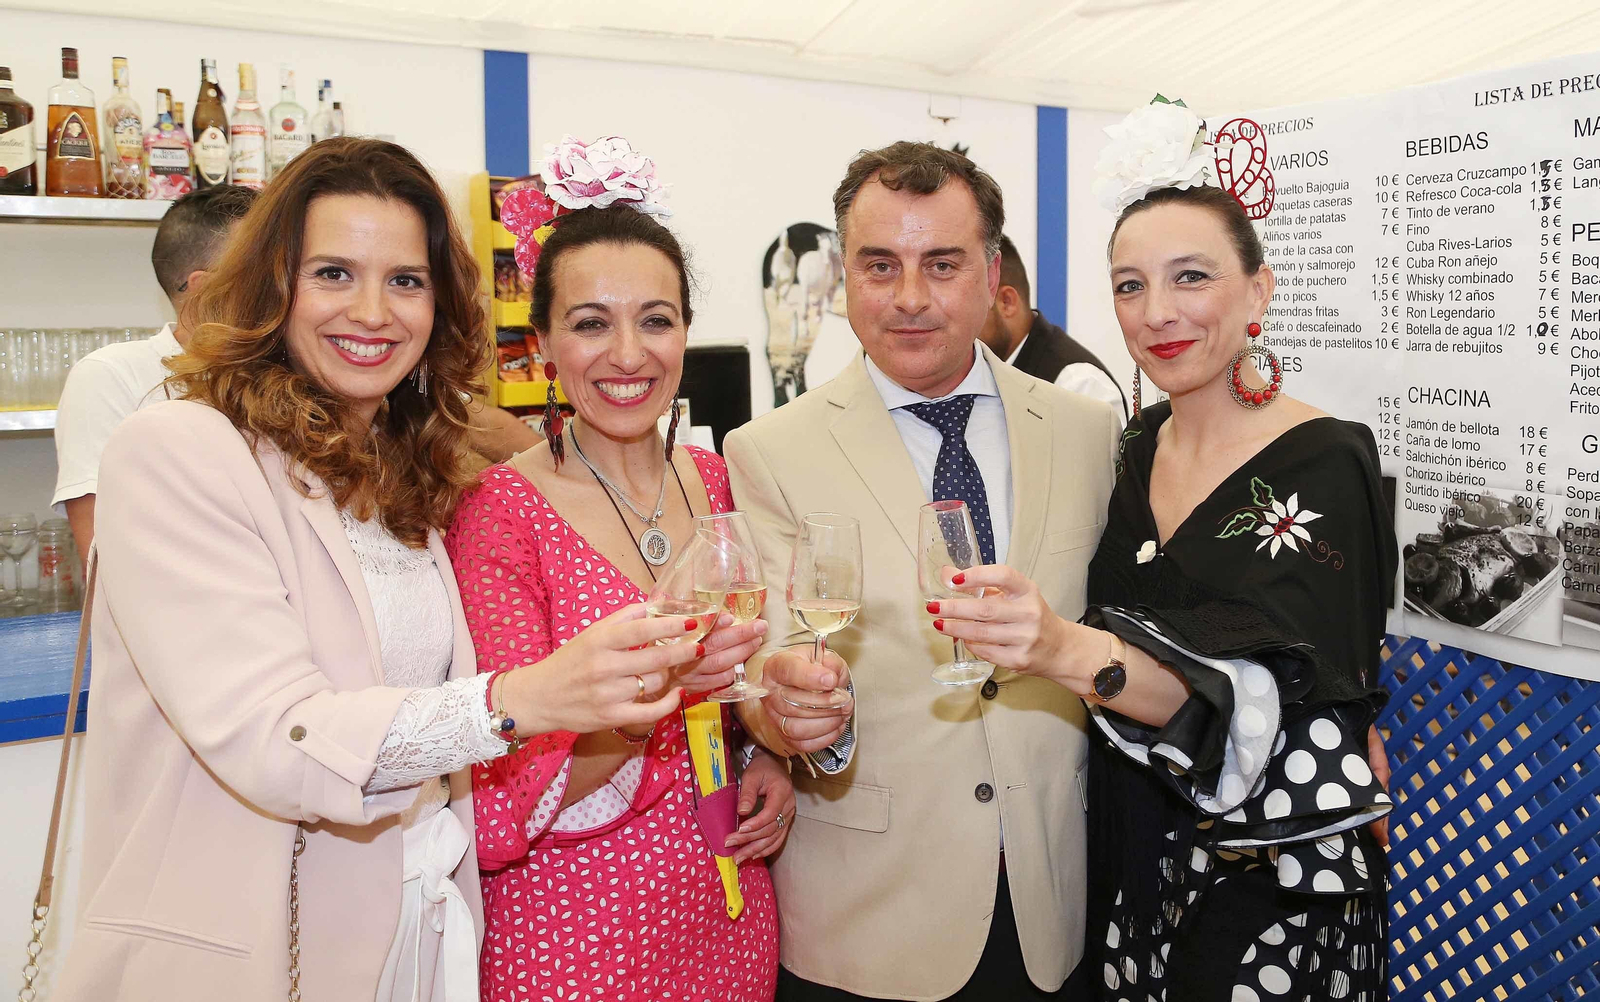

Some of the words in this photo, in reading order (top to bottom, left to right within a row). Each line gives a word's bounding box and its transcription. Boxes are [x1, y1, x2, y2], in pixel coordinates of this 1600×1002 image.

[1474, 86, 1525, 107] LISTA
[1530, 80, 1553, 99] DE
[1261, 117, 1314, 135] PRECIOS
[1406, 132, 1489, 158] BEBIDAS
[1270, 149, 1329, 171] VARIOS
[1406, 172, 1453, 186] Cerveza
[1456, 164, 1527, 182] Cruzcampo
[1306, 180, 1349, 196] Bajoguia
[1375, 175, 1388, 187] 10
[1392, 174, 1400, 186] €
[1406, 188, 1456, 202] Refresco
[1460, 182, 1522, 198] Coca-cola
[1554, 178, 1563, 191] €
[1314, 196, 1352, 209] caseras
[1375, 192, 1388, 204] 10
[1392, 191, 1400, 202] €
[1406, 206, 1432, 219] Tinto
[1436, 205, 1450, 217] de
[1454, 202, 1495, 216] verano
[1553, 196, 1562, 210] €
[1264, 214, 1292, 227] Tortilla
[1295, 213, 1307, 225] de
[1310, 213, 1346, 226] patatas
[1382, 208, 1388, 220] 7
[1392, 207, 1400, 219] €
[1406, 224, 1430, 236] Fino
[1540, 215, 1548, 228] 8
[1552, 214, 1562, 228] €
[1263, 230, 1290, 242] Aliños
[1293, 228, 1322, 241] varios
[1382, 224, 1388, 236] 7
[1392, 224, 1400, 236] €
[1263, 246, 1280, 257] Pan
[1282, 245, 1294, 256] de
[1297, 244, 1306, 256] la
[1308, 246, 1332, 256] casa
[1335, 244, 1354, 254] con
[1406, 240, 1434, 252] Cuba
[1438, 236, 1512, 251] Rives-Larios
[1540, 234, 1548, 247] 5
[1552, 233, 1562, 246] €
[1298, 262, 1304, 273] y
[1307, 259, 1356, 272] salmorejo
[1375, 257, 1388, 268] 12
[1392, 256, 1400, 268] €
[1406, 256, 1434, 268] Cuba
[1438, 256, 1462, 268] Ron
[1464, 254, 1498, 270] añejo
[1540, 252, 1548, 264] 5
[1552, 251, 1561, 264] €
[1292, 276, 1304, 286] de
[1307, 275, 1347, 288] puchero
[1372, 274, 1388, 286] 1,5
[1392, 272, 1400, 285] €
[1406, 274, 1444, 288] Whisky
[1448, 271, 1514, 284] combinado
[1538, 270, 1547, 283] 5
[1551, 270, 1560, 282] €
[1272, 292, 1281, 302] an
[1283, 293, 1290, 302] o
[1292, 290, 1318, 304] picos
[1372, 290, 1388, 302] 1,5
[1392, 289, 1400, 302] €
[1406, 290, 1444, 304] Whisky
[1448, 290, 1462, 302] 12
[1465, 290, 1495, 302] años
[1538, 288, 1546, 301] 7
[1550, 288, 1560, 301] €
[1262, 306, 1313, 317] Almendras
[1316, 306, 1340, 317] fritas
[1381, 306, 1388, 317] 3
[1392, 305, 1400, 318] €
[1406, 306, 1427, 319] Ron
[1430, 306, 1496, 322] Legendario
[1538, 306, 1546, 319] 5
[1550, 306, 1560, 319] €
[1262, 320, 1285, 332] Café
[1287, 322, 1294, 332] o
[1296, 321, 1362, 333] descafeinado
[1381, 322, 1388, 334] 2
[1392, 321, 1400, 334] €
[1406, 323, 1442, 336] Botella
[1444, 324, 1460, 336] de
[1462, 326, 1493, 338] agua
[1497, 324, 1516, 336] 1/2
[1550, 324, 1560, 338] €
[1263, 336, 1306, 349] Bandejas
[1309, 336, 1322, 348] de
[1324, 337, 1372, 350] pastelitos
[1375, 338, 1388, 350] 10
[1392, 338, 1400, 350] €
[1406, 340, 1432, 352] Jarra
[1434, 340, 1449, 352] de
[1452, 340, 1503, 356] rebujitos
[1538, 342, 1546, 355] 9
[1550, 342, 1560, 356] €
[1377, 396, 1390, 408] 15
[1408, 386, 1491, 408] CHACINA
[1378, 412, 1390, 424] 12
[1378, 428, 1390, 440] 12
[1406, 417, 1438, 432] Jamón
[1442, 420, 1456, 432] de
[1460, 421, 1500, 436] bellota
[1519, 426, 1536, 438] 18
[1539, 426, 1548, 440] €
[1378, 444, 1390, 456] 12
[1406, 433, 1430, 447] Caña
[1434, 436, 1448, 448] de
[1452, 438, 1481, 452] lomo
[1519, 443, 1535, 456] 17
[1538, 444, 1548, 458] €
[1582, 434, 1598, 454] G
[1405, 449, 1462, 467] Salchichón
[1465, 455, 1506, 472] ibérico
[1526, 461, 1534, 474] 8
[1537, 462, 1546, 476] €
[1405, 465, 1443, 482] Chorizo
[1446, 470, 1486, 486] ibérico
[1526, 479, 1533, 492] 8
[1536, 480, 1546, 493] €
[1568, 467, 1599, 483] Perd
[1405, 482, 1440, 498] Surtido
[1442, 486, 1481, 504] ibérico
[1516, 496, 1532, 509] 20
[1404, 498, 1436, 514] Queso
[1440, 502, 1466, 520] viejo
[1516, 514, 1532, 527] 12
[1566, 506, 1590, 519] con
